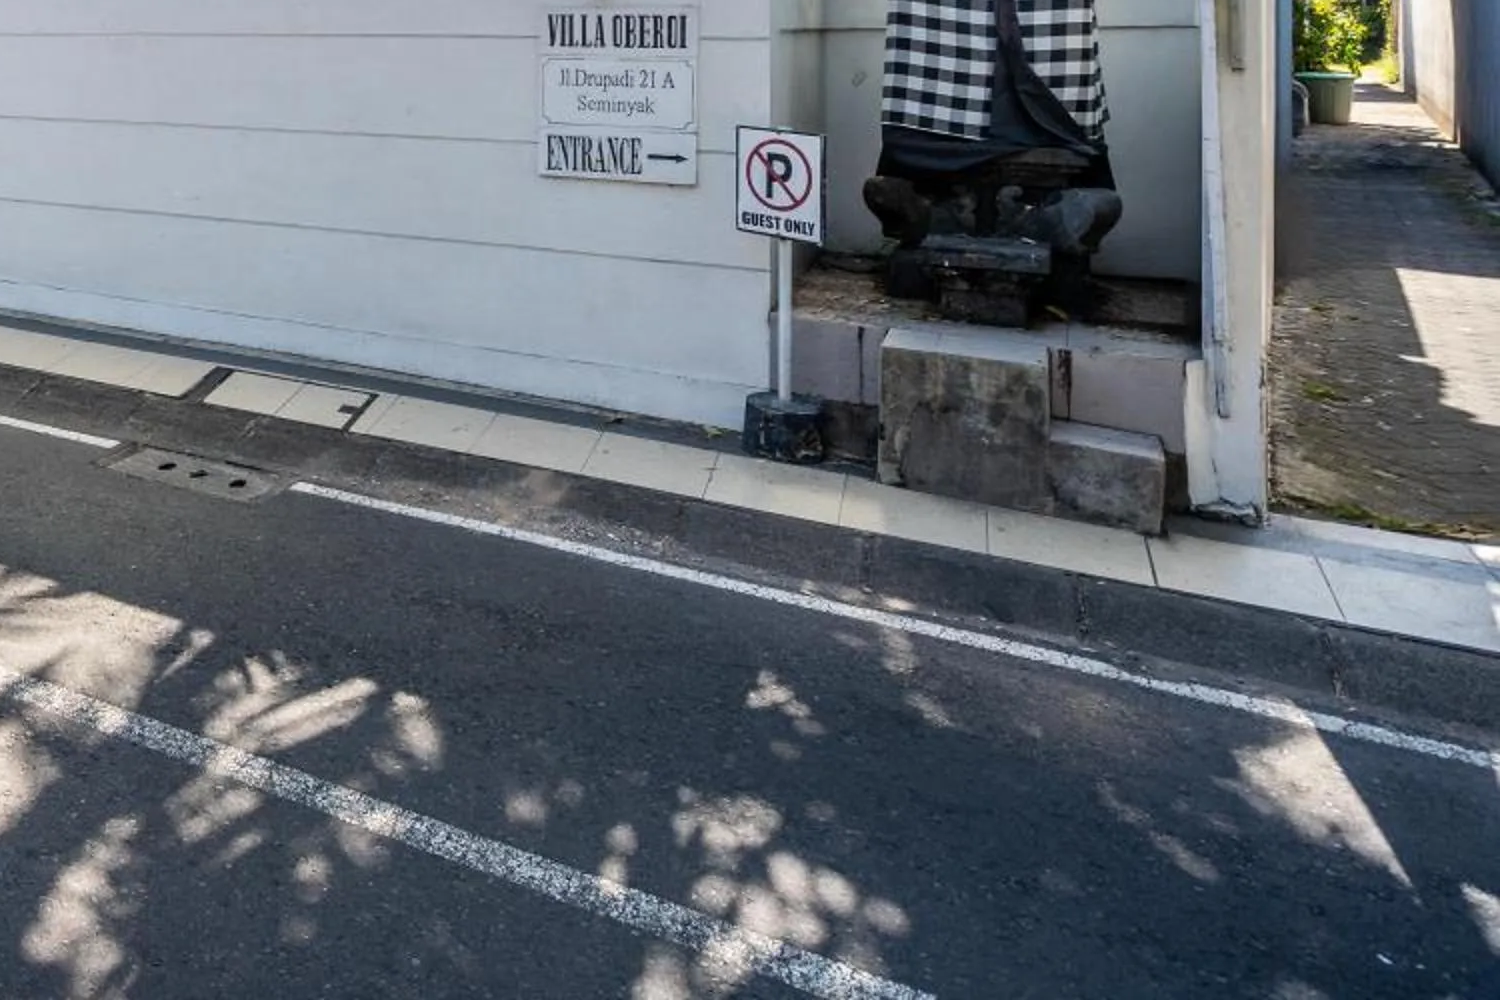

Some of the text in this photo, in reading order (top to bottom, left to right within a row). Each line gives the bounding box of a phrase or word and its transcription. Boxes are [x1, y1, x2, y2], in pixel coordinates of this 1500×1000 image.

[547, 13, 688, 49] VILLA OBEROI
[639, 70, 656, 88] 21
[661, 72, 675, 89] A
[577, 95, 655, 117] Seminyak
[546, 135, 643, 175] ENTRANCE
[765, 152, 793, 198] P
[742, 211, 815, 236] GUEST ONLY
